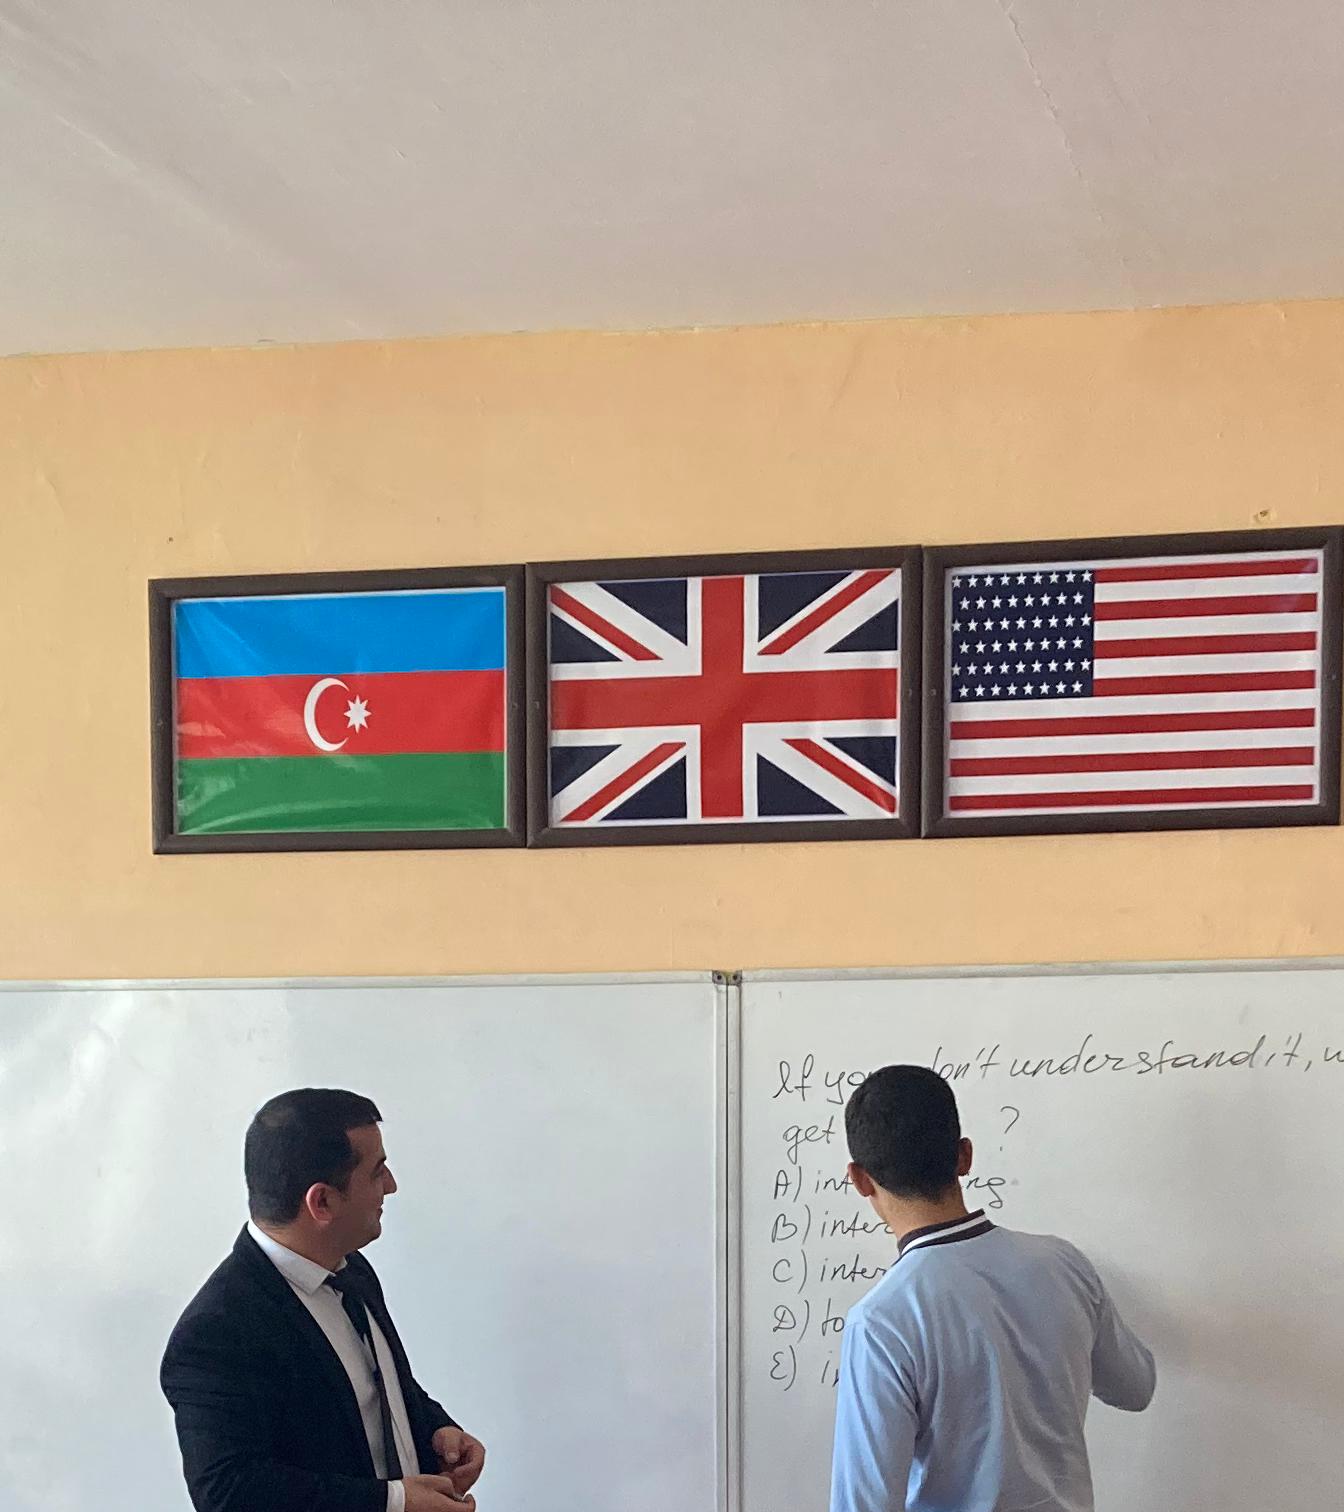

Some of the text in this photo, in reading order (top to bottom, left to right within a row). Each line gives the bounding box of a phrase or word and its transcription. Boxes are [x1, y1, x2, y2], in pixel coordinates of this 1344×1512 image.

[772, 1053, 815, 1101] If
[824, 1071, 873, 1105] yo
[1008, 1033, 1266, 1079] understand
[782, 1116, 837, 1165] get
